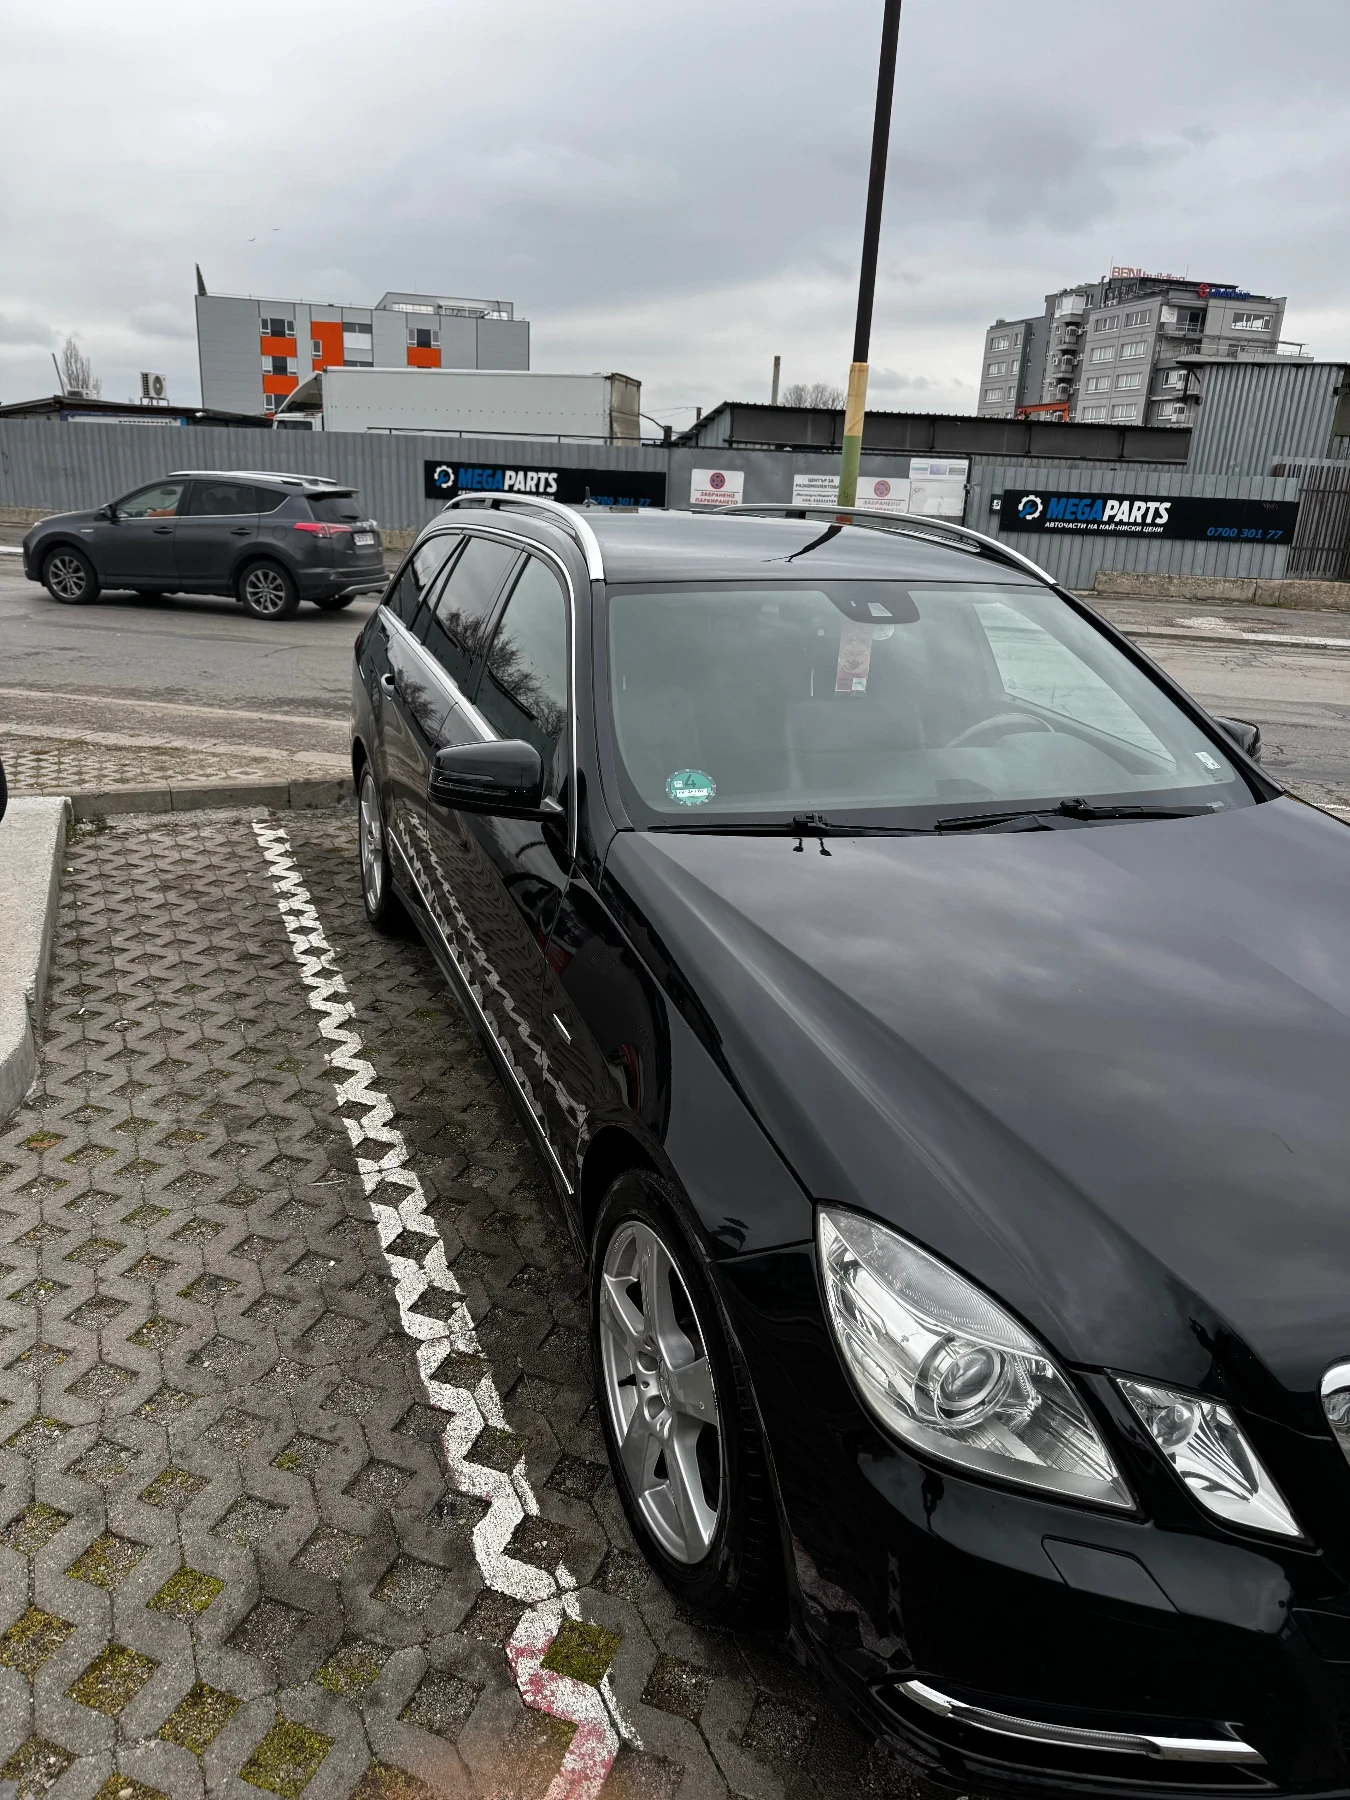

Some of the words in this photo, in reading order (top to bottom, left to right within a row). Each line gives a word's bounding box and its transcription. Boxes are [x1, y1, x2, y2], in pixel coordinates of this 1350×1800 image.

[1112, 266, 1141, 278] BENI
[458, 467, 558, 493] MEGAPARTS
[617, 497, 635, 506] 301
[639, 498, 651, 507] 77
[1045, 497, 1171, 524] MEGAPARTS
[1099, 523, 1142, 532] НАЙ-НИСКИ
[1206, 527, 1238, 537] 0700
[1240, 528, 1263, 538] 301
[1266, 530, 1283, 539] 77
[685, 774, 696, 787] 4
